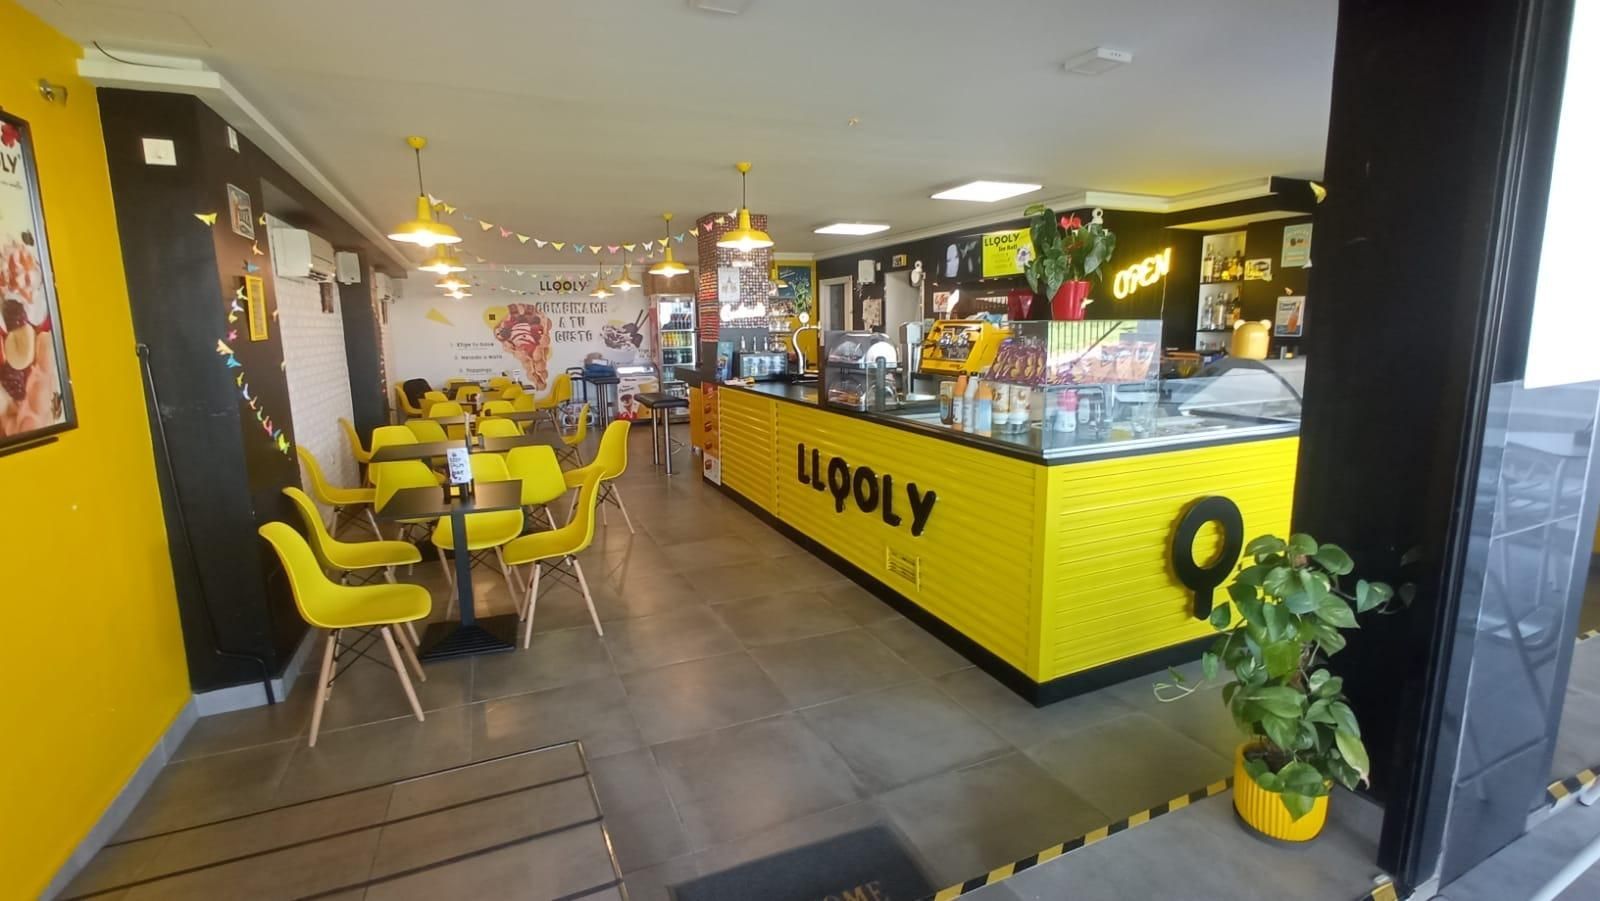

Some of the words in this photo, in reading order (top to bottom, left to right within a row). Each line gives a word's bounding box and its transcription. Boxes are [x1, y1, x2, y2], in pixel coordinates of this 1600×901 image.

[0, 151, 17, 174] LY
[1113, 247, 1172, 300] OPEN
[569, 316, 585, 328] TU
[554, 330, 593, 342] GUSTO
